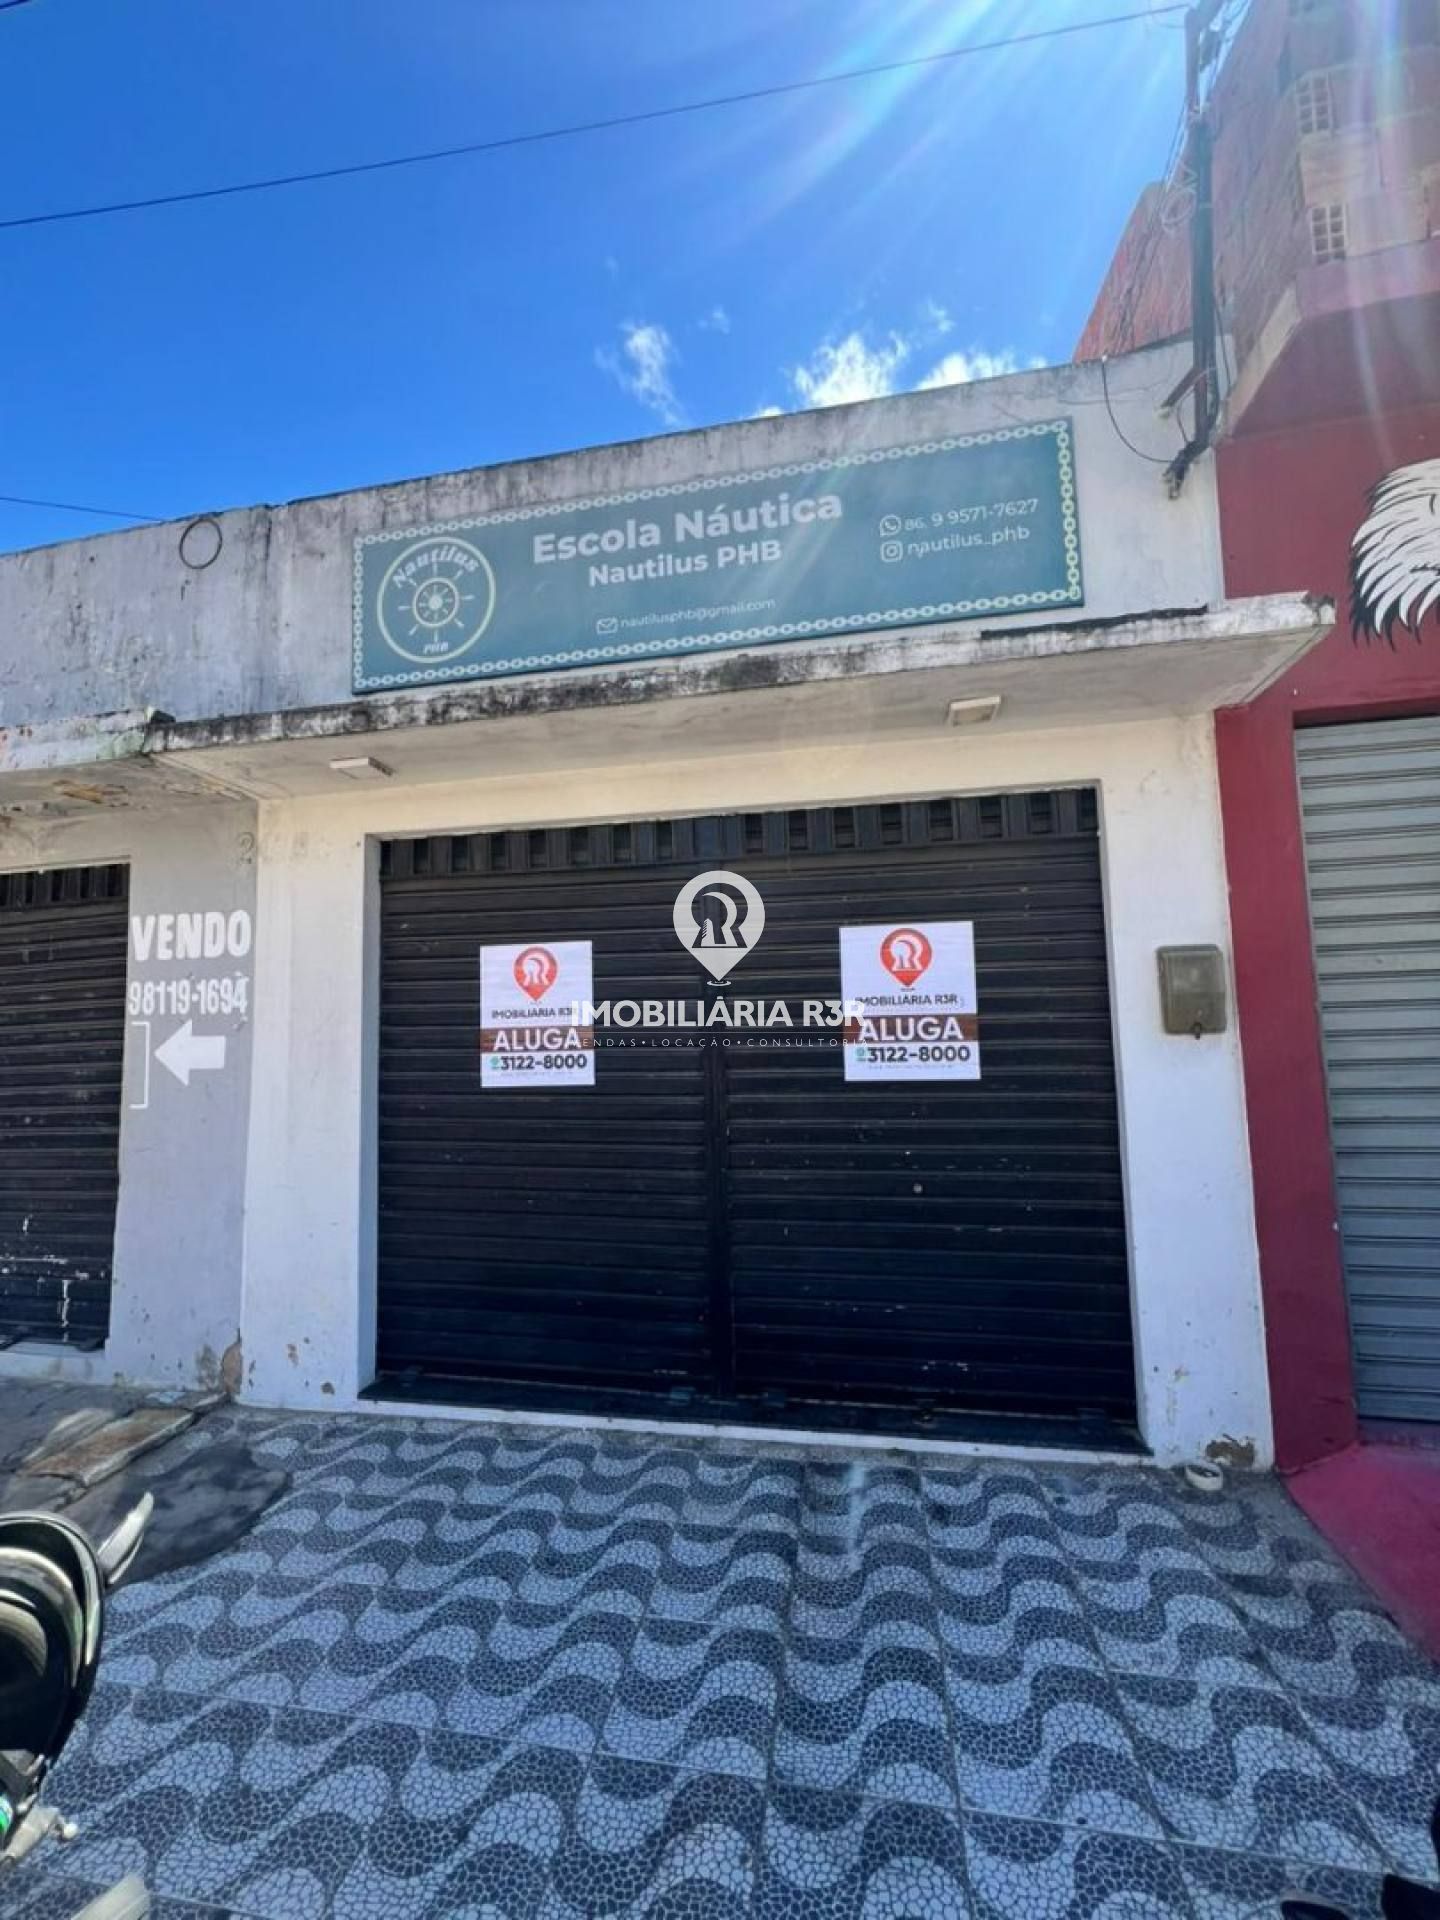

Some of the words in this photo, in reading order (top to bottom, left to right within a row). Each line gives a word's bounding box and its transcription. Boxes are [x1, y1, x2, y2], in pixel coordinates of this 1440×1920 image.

[532, 519, 661, 564] Escola
[674, 493, 843, 542] Náutica
[931, 513, 944, 527] 9
[947, 498, 1039, 524] 9571-7627
[392, 545, 480, 588] Nautilus
[588, 554, 709, 587] Nautilus
[717, 539, 782, 568] PHB
[131, 909, 251, 961] VENDO
[128, 976, 250, 1016] 98119-1694
[493, 1027, 582, 1051] ALUGA
[858, 1016, 964, 1041] ALUGA
[501, 1054, 588, 1071] 3122-8000
[867, 1046, 971, 1062] 3122-8000
